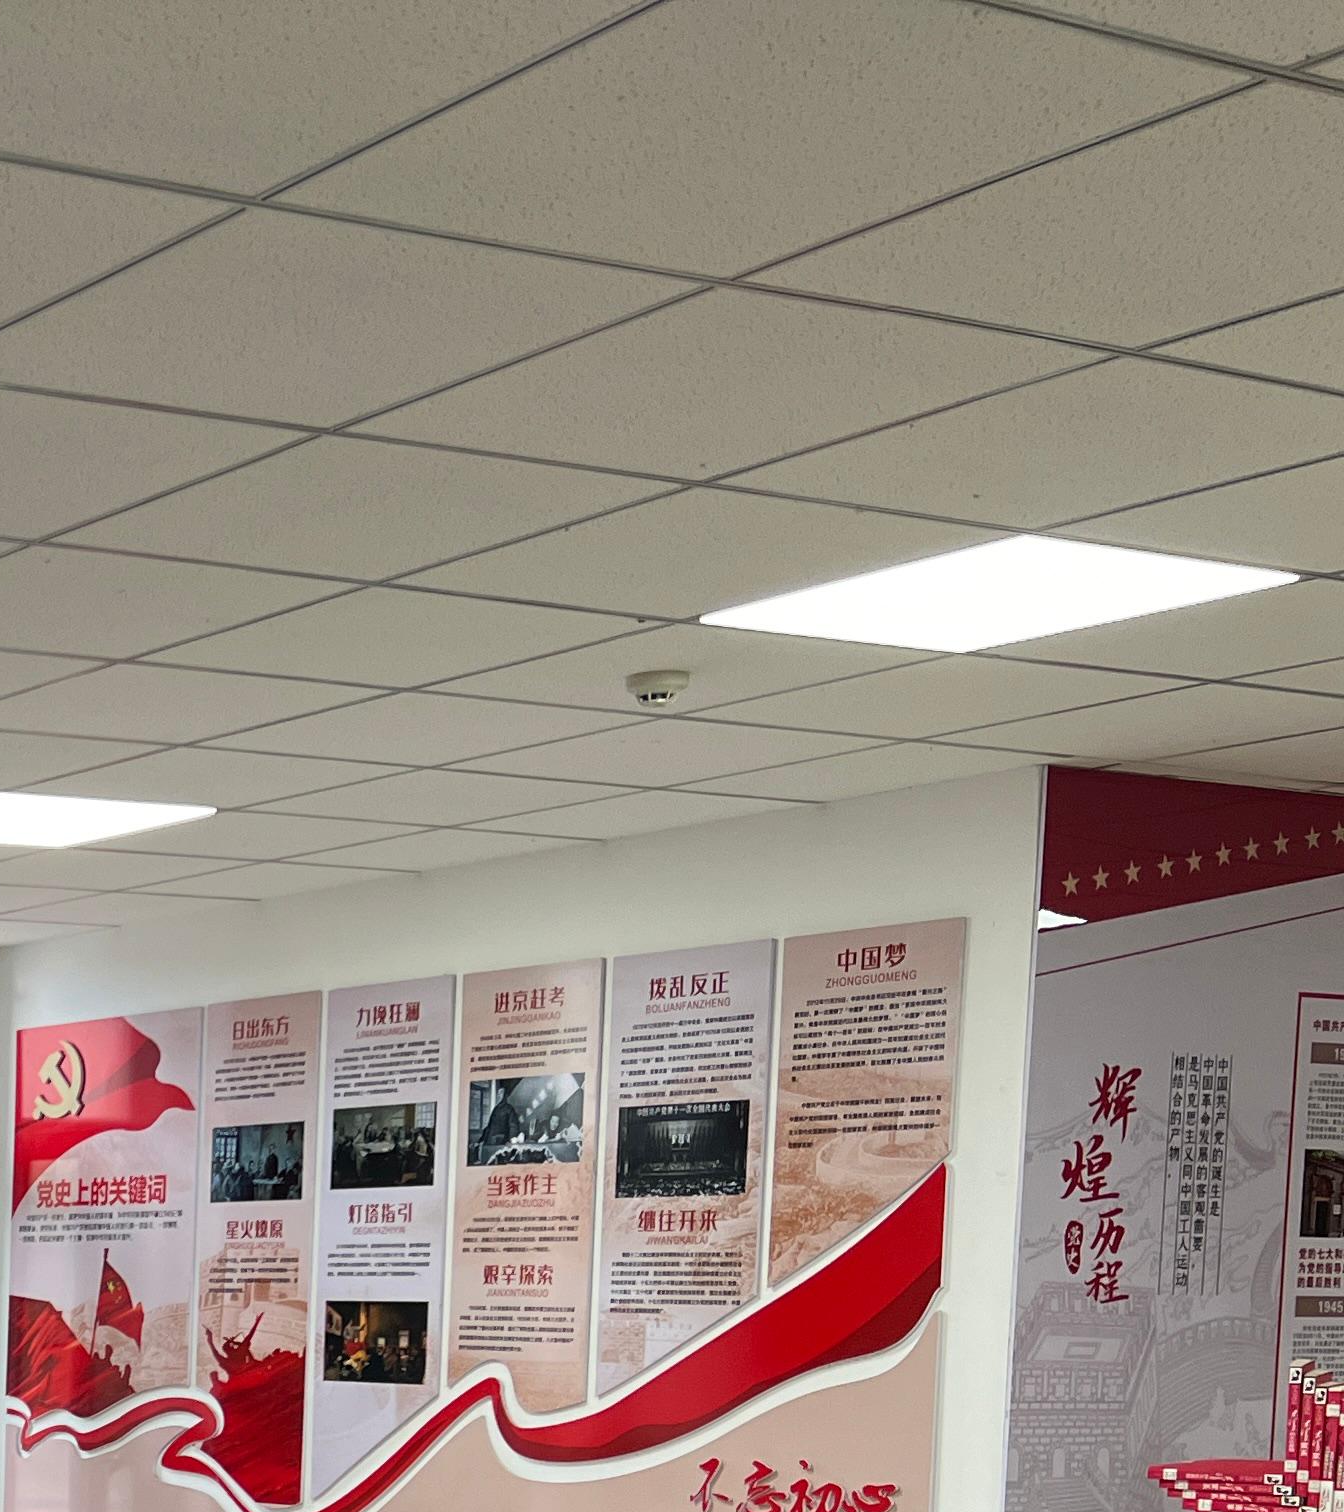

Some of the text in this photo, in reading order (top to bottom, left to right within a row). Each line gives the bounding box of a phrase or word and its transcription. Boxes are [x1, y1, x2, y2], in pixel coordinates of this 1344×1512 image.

[837, 942, 907, 973] 中国梦
[650, 971, 730, 1001] 拨乱反正
[825, 969, 918, 989] ZHONGGUOMENG
[494, 986, 566, 1014] 进京赶考
[646, 996, 731, 1015] BOLUANFANZHENG
[356, 1002, 420, 1028] 力挽狂澜
[232, 1015, 290, 1040] 日出东方
[1209, 1057, 1229, 1218] 中国共产党的诞生是
[1060, 1062, 1143, 1304] 辉煌历程
[1175, 1056, 1200, 1288] 是马克思主义同中国工人运动
[36, 1174, 168, 1209] 党史上的关键词
[487, 1174, 558, 1197] 当家作主
[348, 1202, 413, 1225] 灯塔指引
[638, 1208, 718, 1232] 继往开来
[226, 1219, 284, 1240] 星火燎原
[1299, 1248, 1343, 1260] 党的七大和
[483, 1264, 554, 1286] 艰辛探索
[1298, 1262, 1344, 1275] 为党的指导
[1318, 1301, 1343, 1314] 1945
